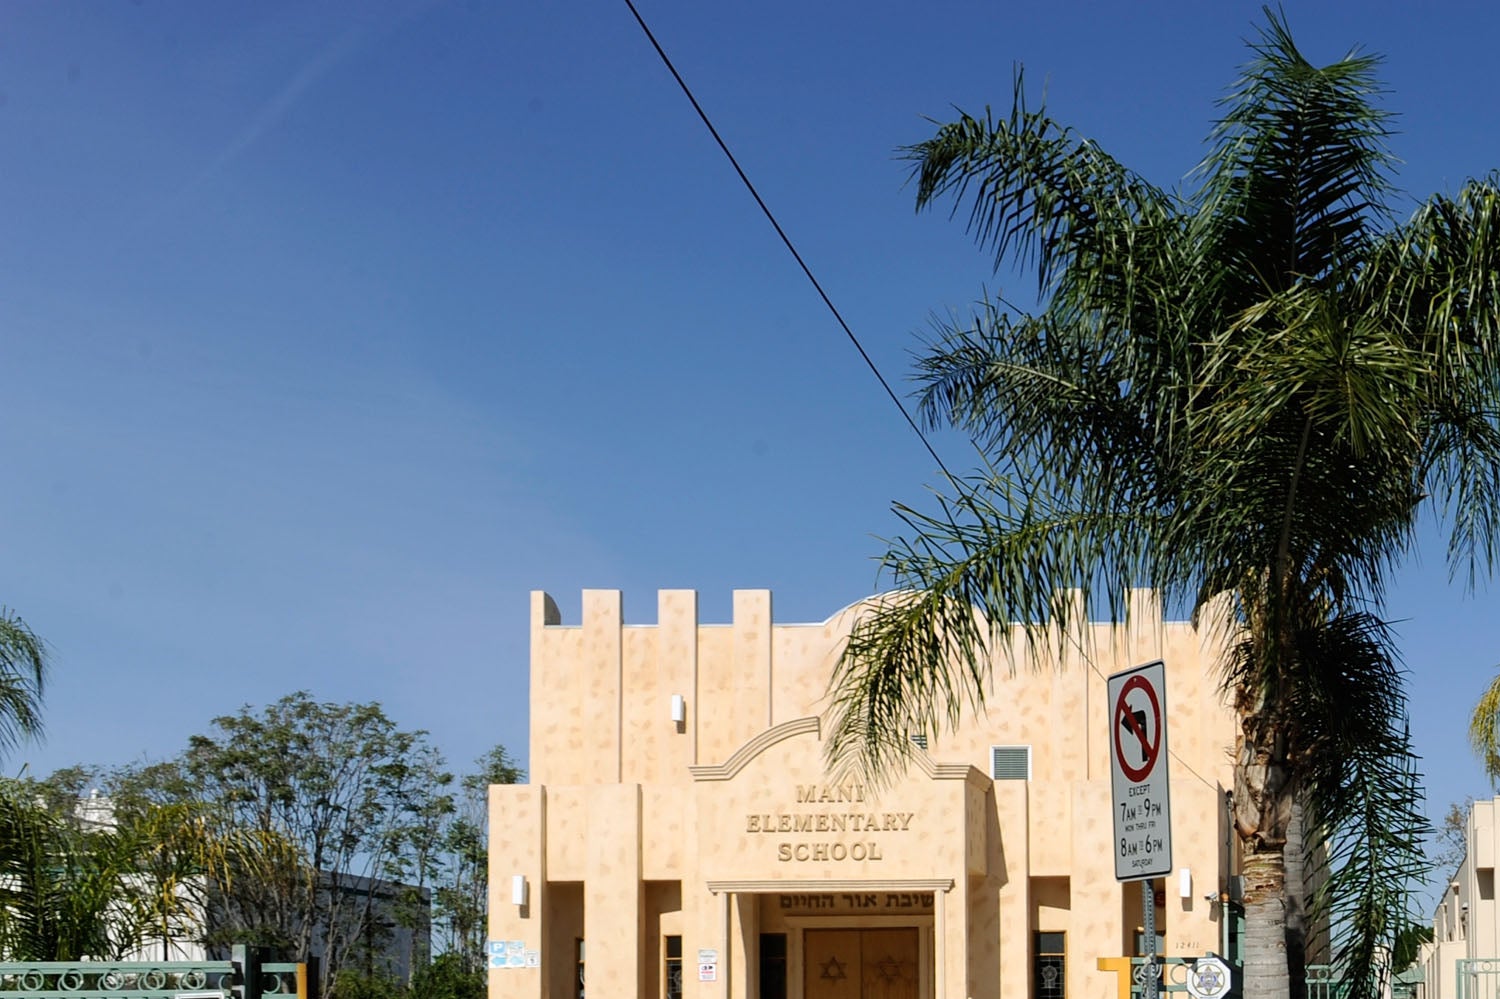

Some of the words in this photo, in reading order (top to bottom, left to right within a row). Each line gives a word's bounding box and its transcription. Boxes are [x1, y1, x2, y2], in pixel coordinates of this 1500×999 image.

[1128, 784, 1150, 797] EXCEPT
[746, 812, 914, 833] ELEMENTARY
[777, 842, 883, 862] SCHOOL
[885, 893, 934, 908] שיבת
